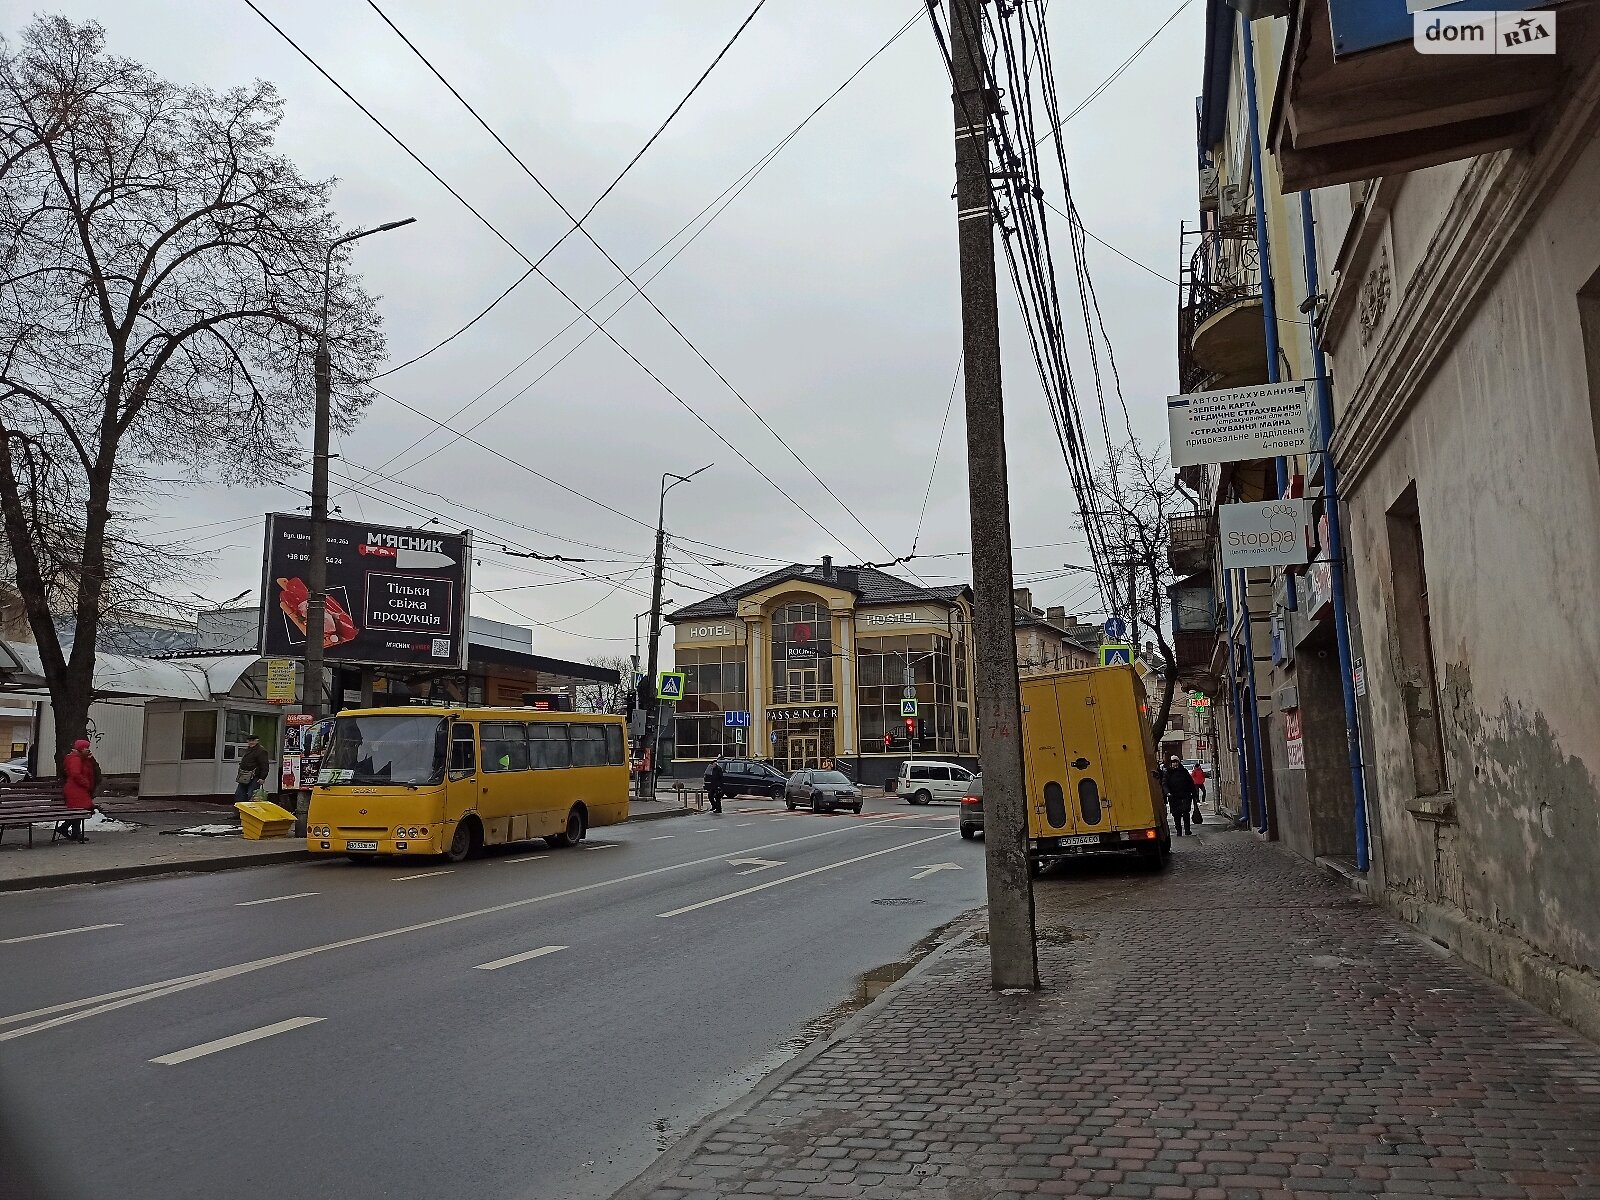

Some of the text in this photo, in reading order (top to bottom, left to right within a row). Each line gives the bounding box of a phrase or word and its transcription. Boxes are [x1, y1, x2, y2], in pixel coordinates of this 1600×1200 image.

[1193, 387, 1294, 405] АВТОСТРАХУВАННЯ
[1193, 401, 1257, 414] ЗЕЛЕНА КАРТА
[1193, 403, 1302, 422] МЕДИЧНЕ СТРАХУВАННЯ
[1195, 419, 1292, 435] СТРАХУВАННЯ МАЙНА
[1186, 427, 1305, 448] привокзальне відділення
[1262, 439, 1305, 449] 4-поверх
[367, 532, 443, 553] М'ЯСНИК
[1228, 530, 1294, 547] Stoppa
[386, 582, 431, 597] Тільки
[388, 597, 428, 610] свіжа
[373, 611, 441, 626] продукція
[866, 612, 919, 626] HOSTEL
[690, 625, 730, 638] HOTEL
